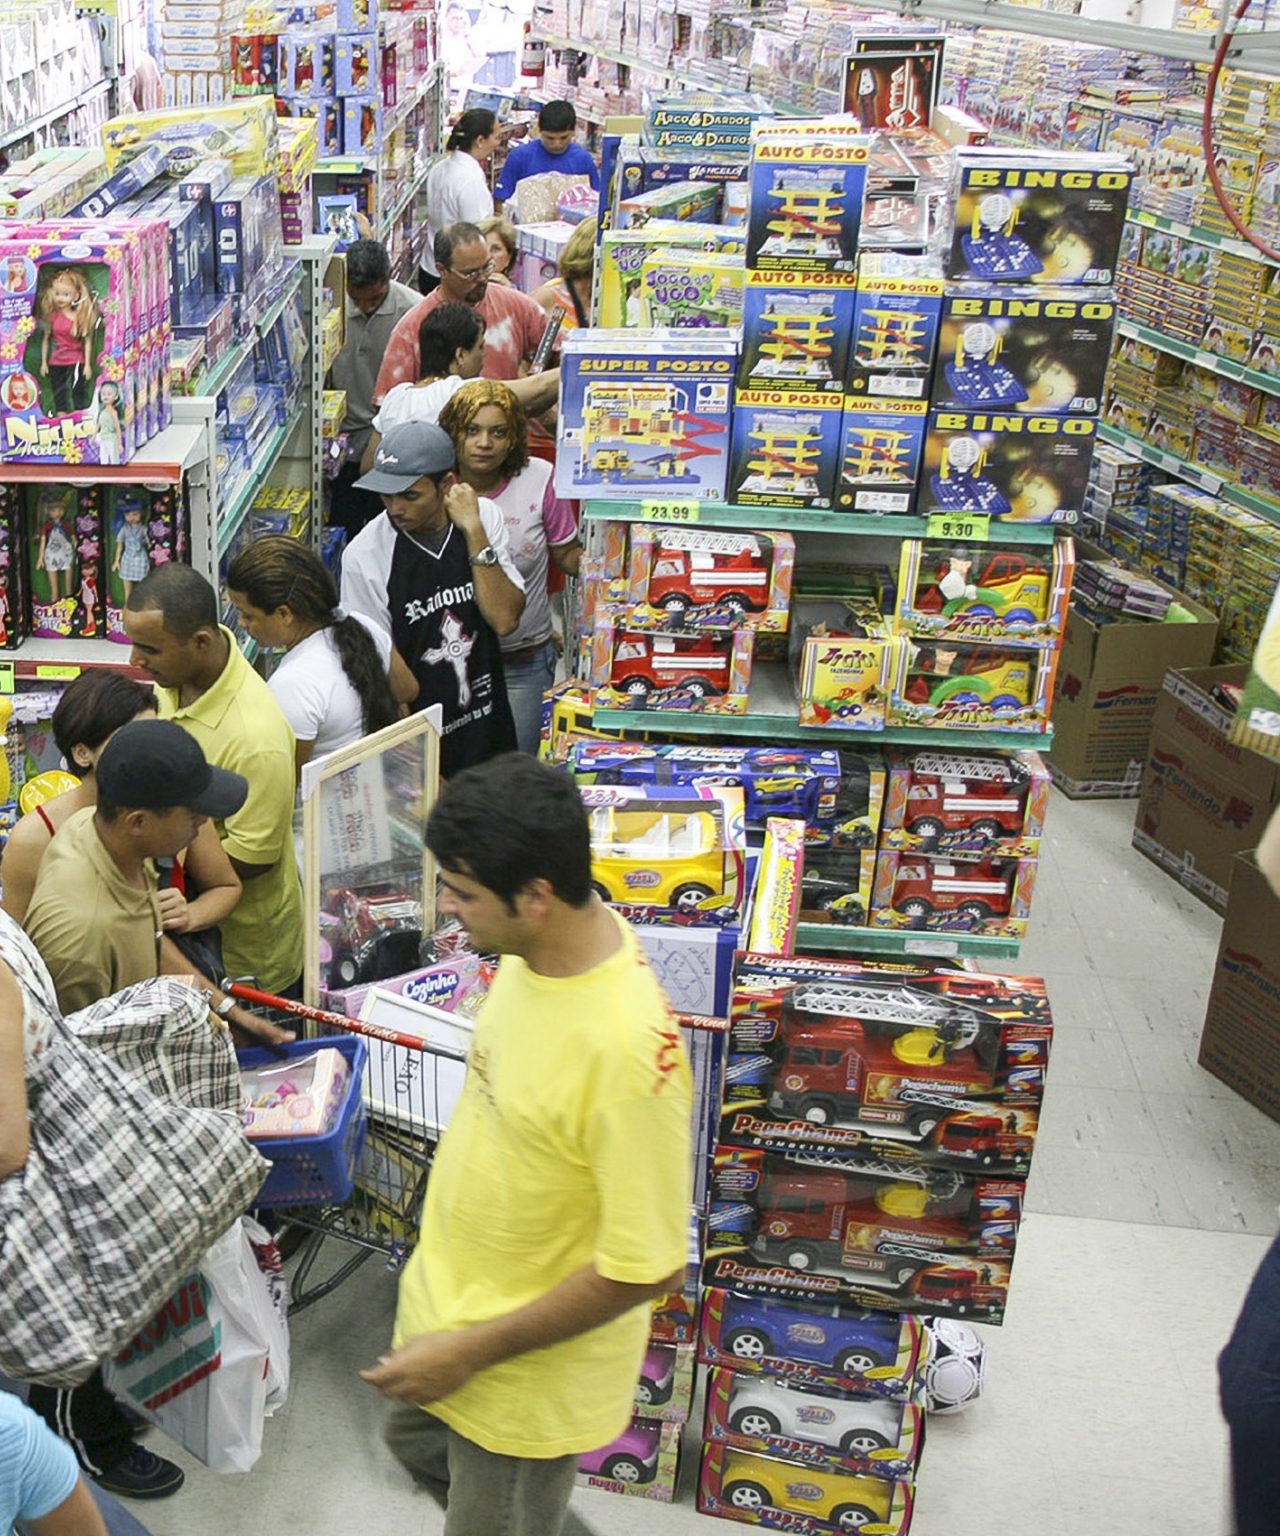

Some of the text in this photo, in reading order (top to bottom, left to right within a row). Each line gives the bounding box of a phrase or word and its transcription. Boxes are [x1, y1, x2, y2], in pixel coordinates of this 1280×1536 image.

[759, 146, 867, 160] AUTO POSTO
[968, 170, 1129, 190] BINGO
[751, 272, 855, 285] AUTO POSTO
[865, 281, 939, 293] AUTO POSTO
[951, 300, 1113, 319] BINGO
[579, 360, 730, 372] SUPER POSTO
[739, 391, 841, 405] AUTO POSTO
[6, 414, 97, 448] Nicki
[936, 413, 1095, 434] BINGO
[16, 438, 62, 458] Model
[651, 507, 689, 519] 23.99
[942, 523, 973, 536] 9.30
[1165, 768, 1220, 815] Fernando
[402, 972, 458, 1001] Cozinha
[752, 1137, 835, 1154] BOMBEIRO
[735, 1281, 816, 1299] BOMBEIRO
[588, 1475, 625, 1494] Buggy
